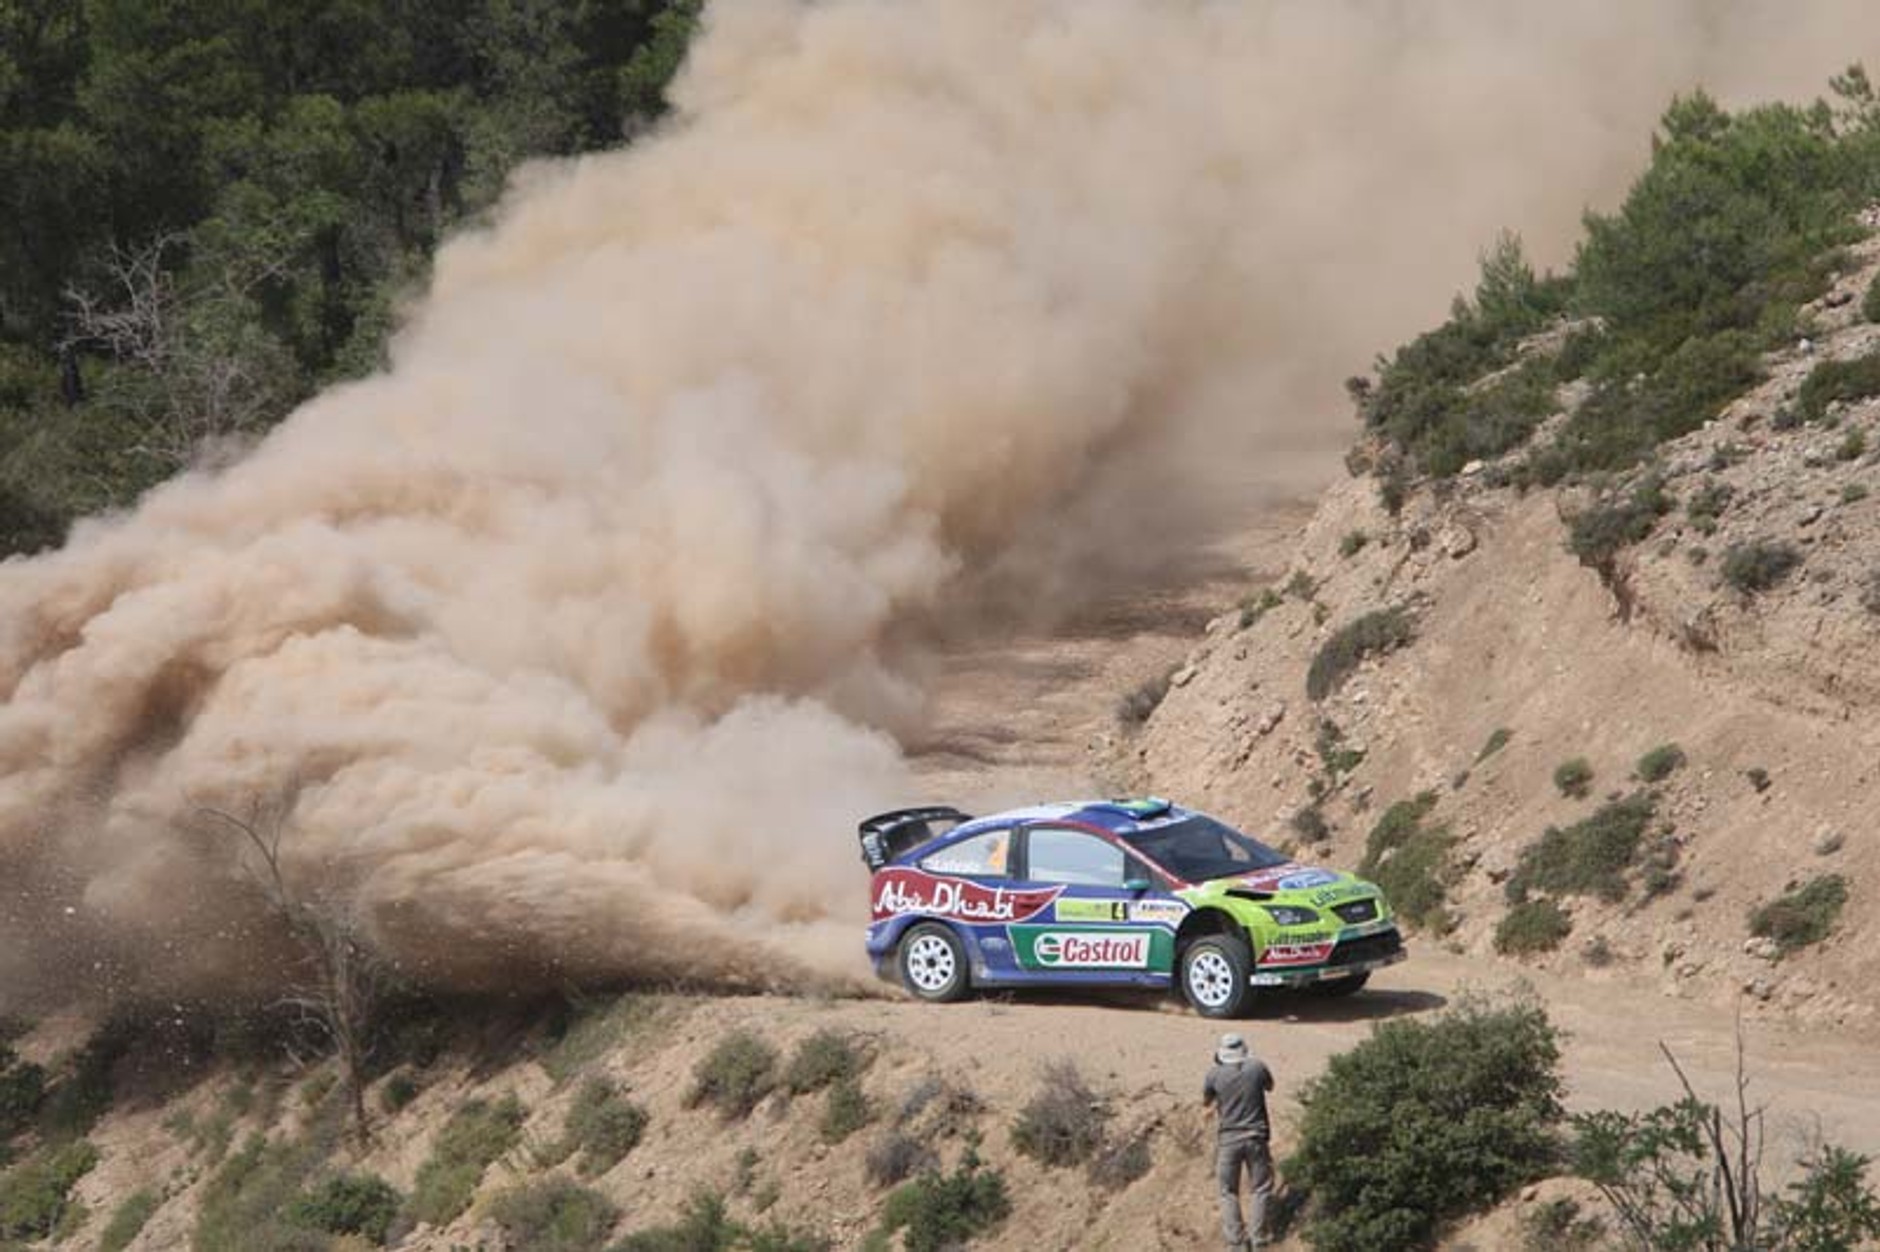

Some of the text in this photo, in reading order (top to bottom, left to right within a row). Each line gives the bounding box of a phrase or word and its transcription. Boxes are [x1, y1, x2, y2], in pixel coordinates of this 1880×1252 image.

[875, 881, 1015, 918] Abu Dhabi
[1063, 937, 1141, 962] Castrol
